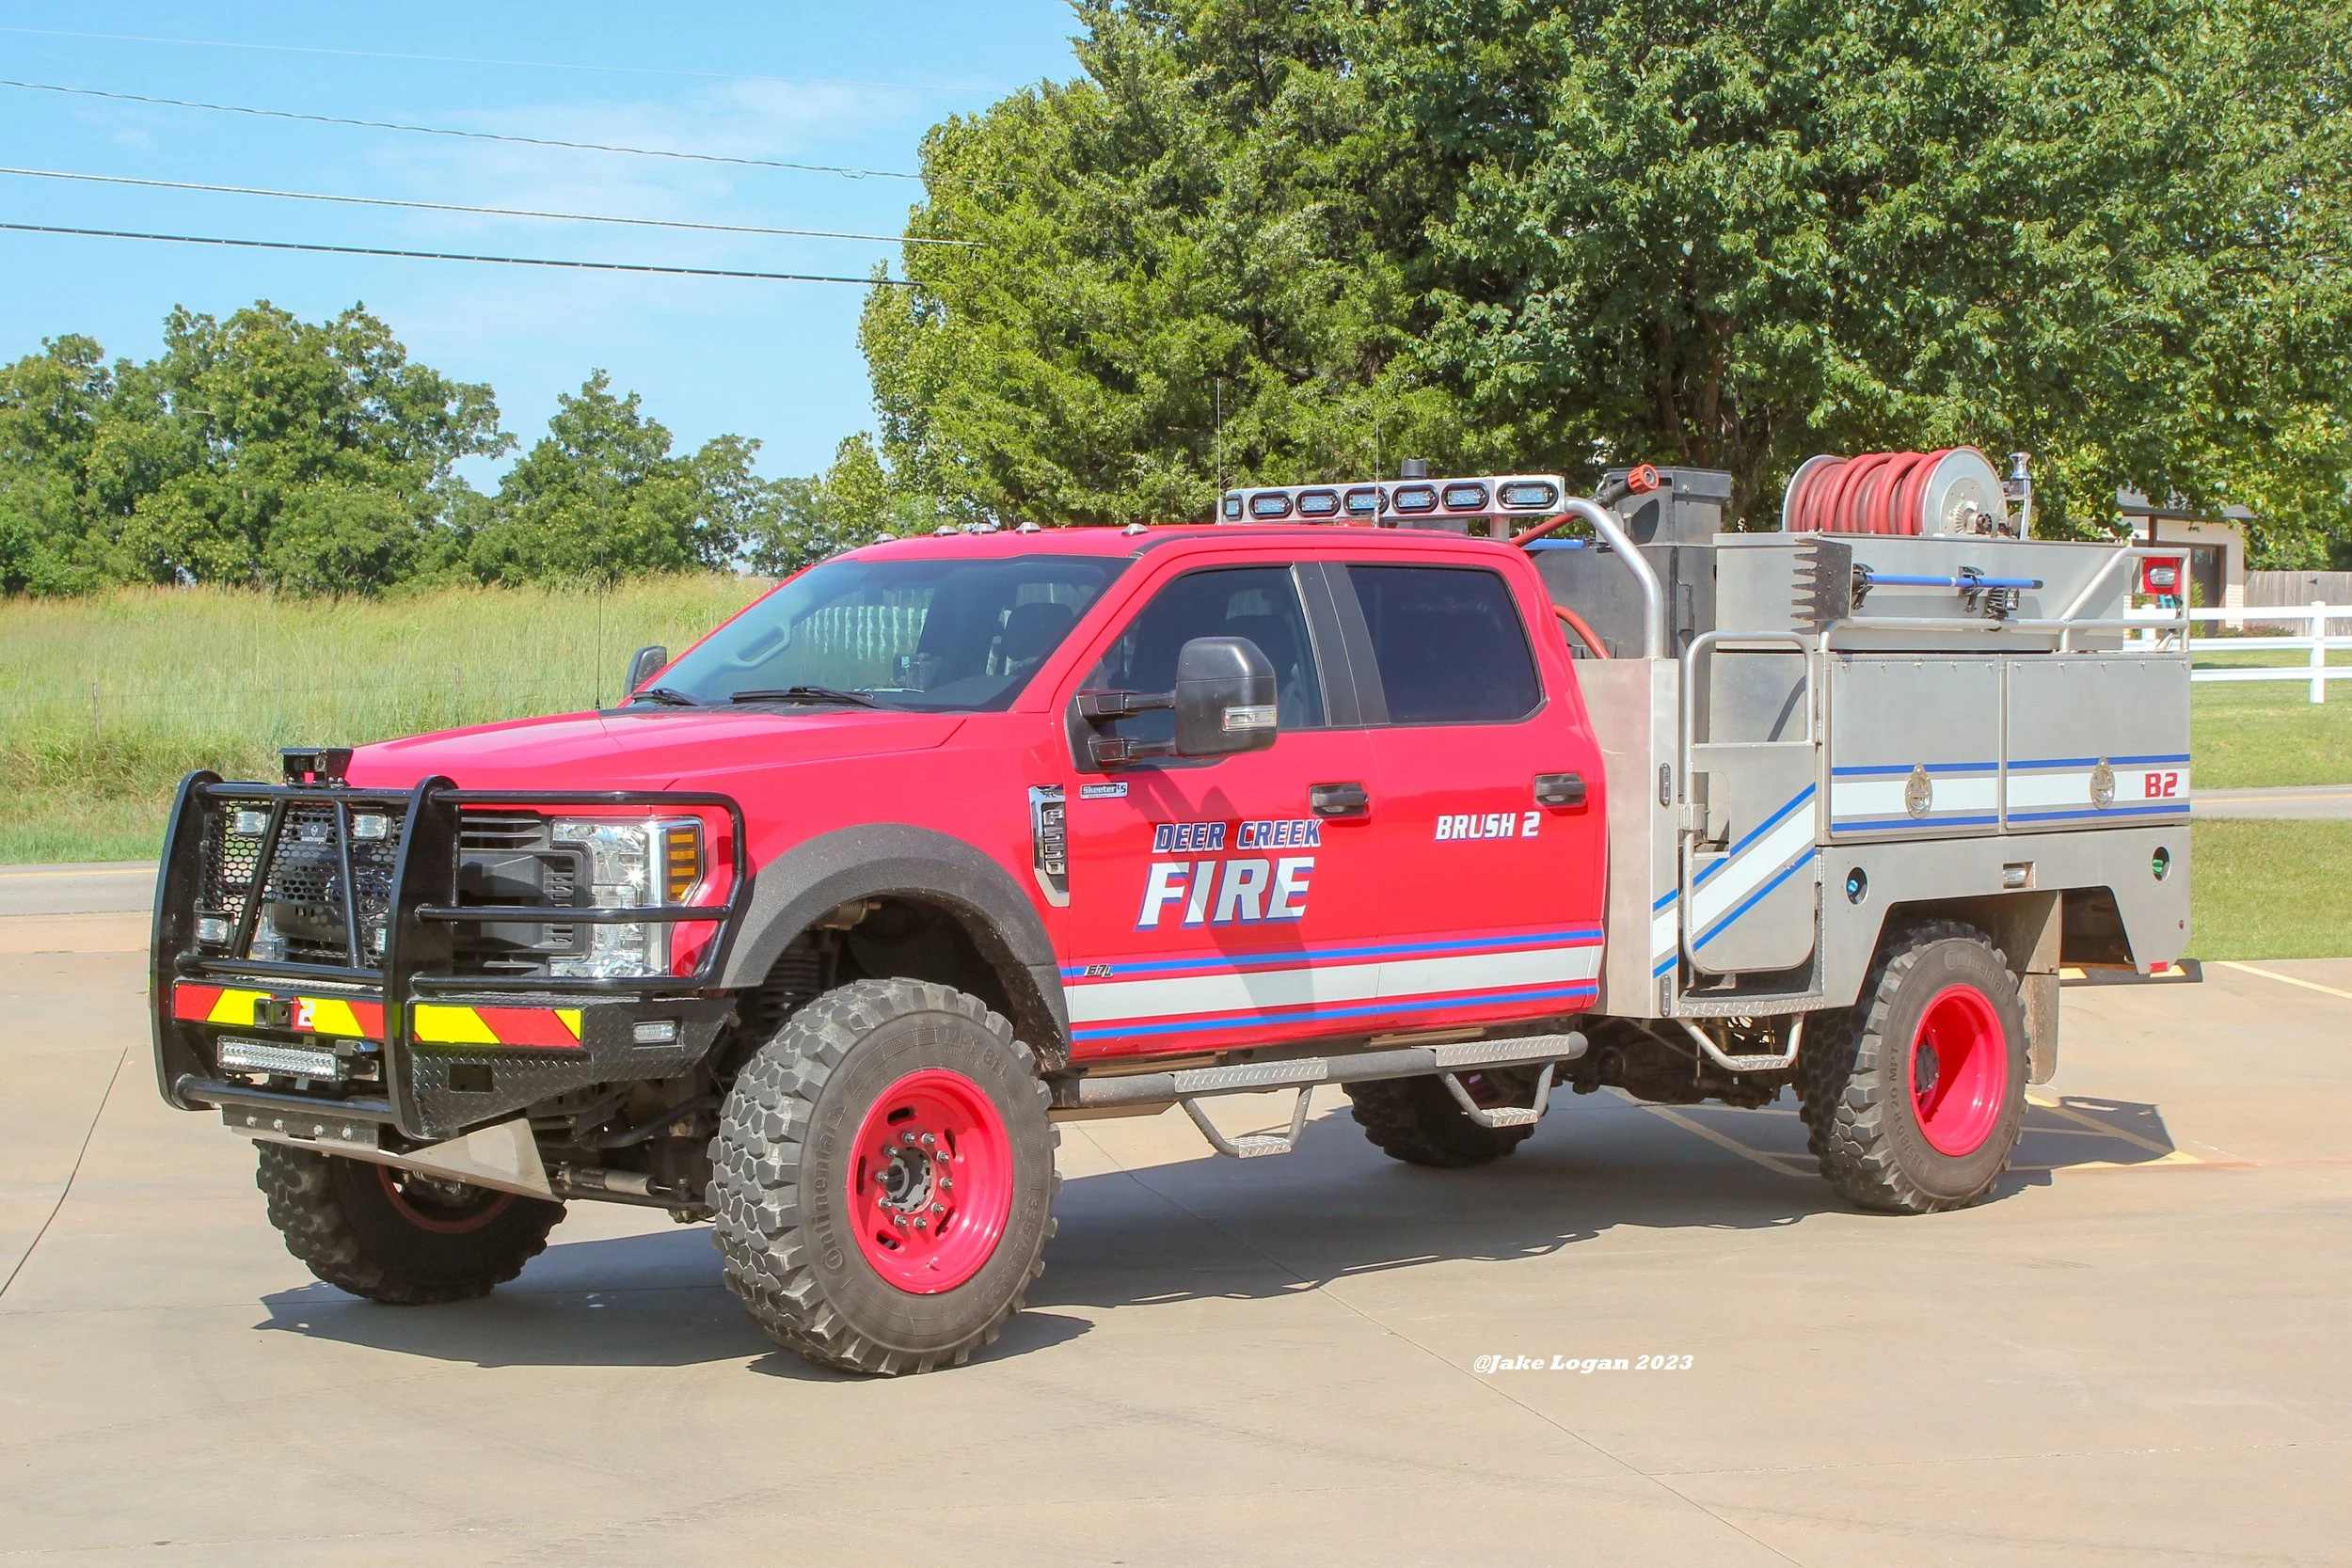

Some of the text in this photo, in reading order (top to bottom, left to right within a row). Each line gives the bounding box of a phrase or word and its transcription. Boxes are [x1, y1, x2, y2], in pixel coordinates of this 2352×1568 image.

[1082, 784, 1117, 795] Skeeter
[2144, 772, 2178, 798] B2
[1152, 818, 1325, 854] DEER CREEK
[1435, 810, 1541, 842] BRUSH 2
[1134, 856, 1315, 931] FIRE
[297, 999, 316, 1028] 2
[811, 1120, 845, 1274] Continental
